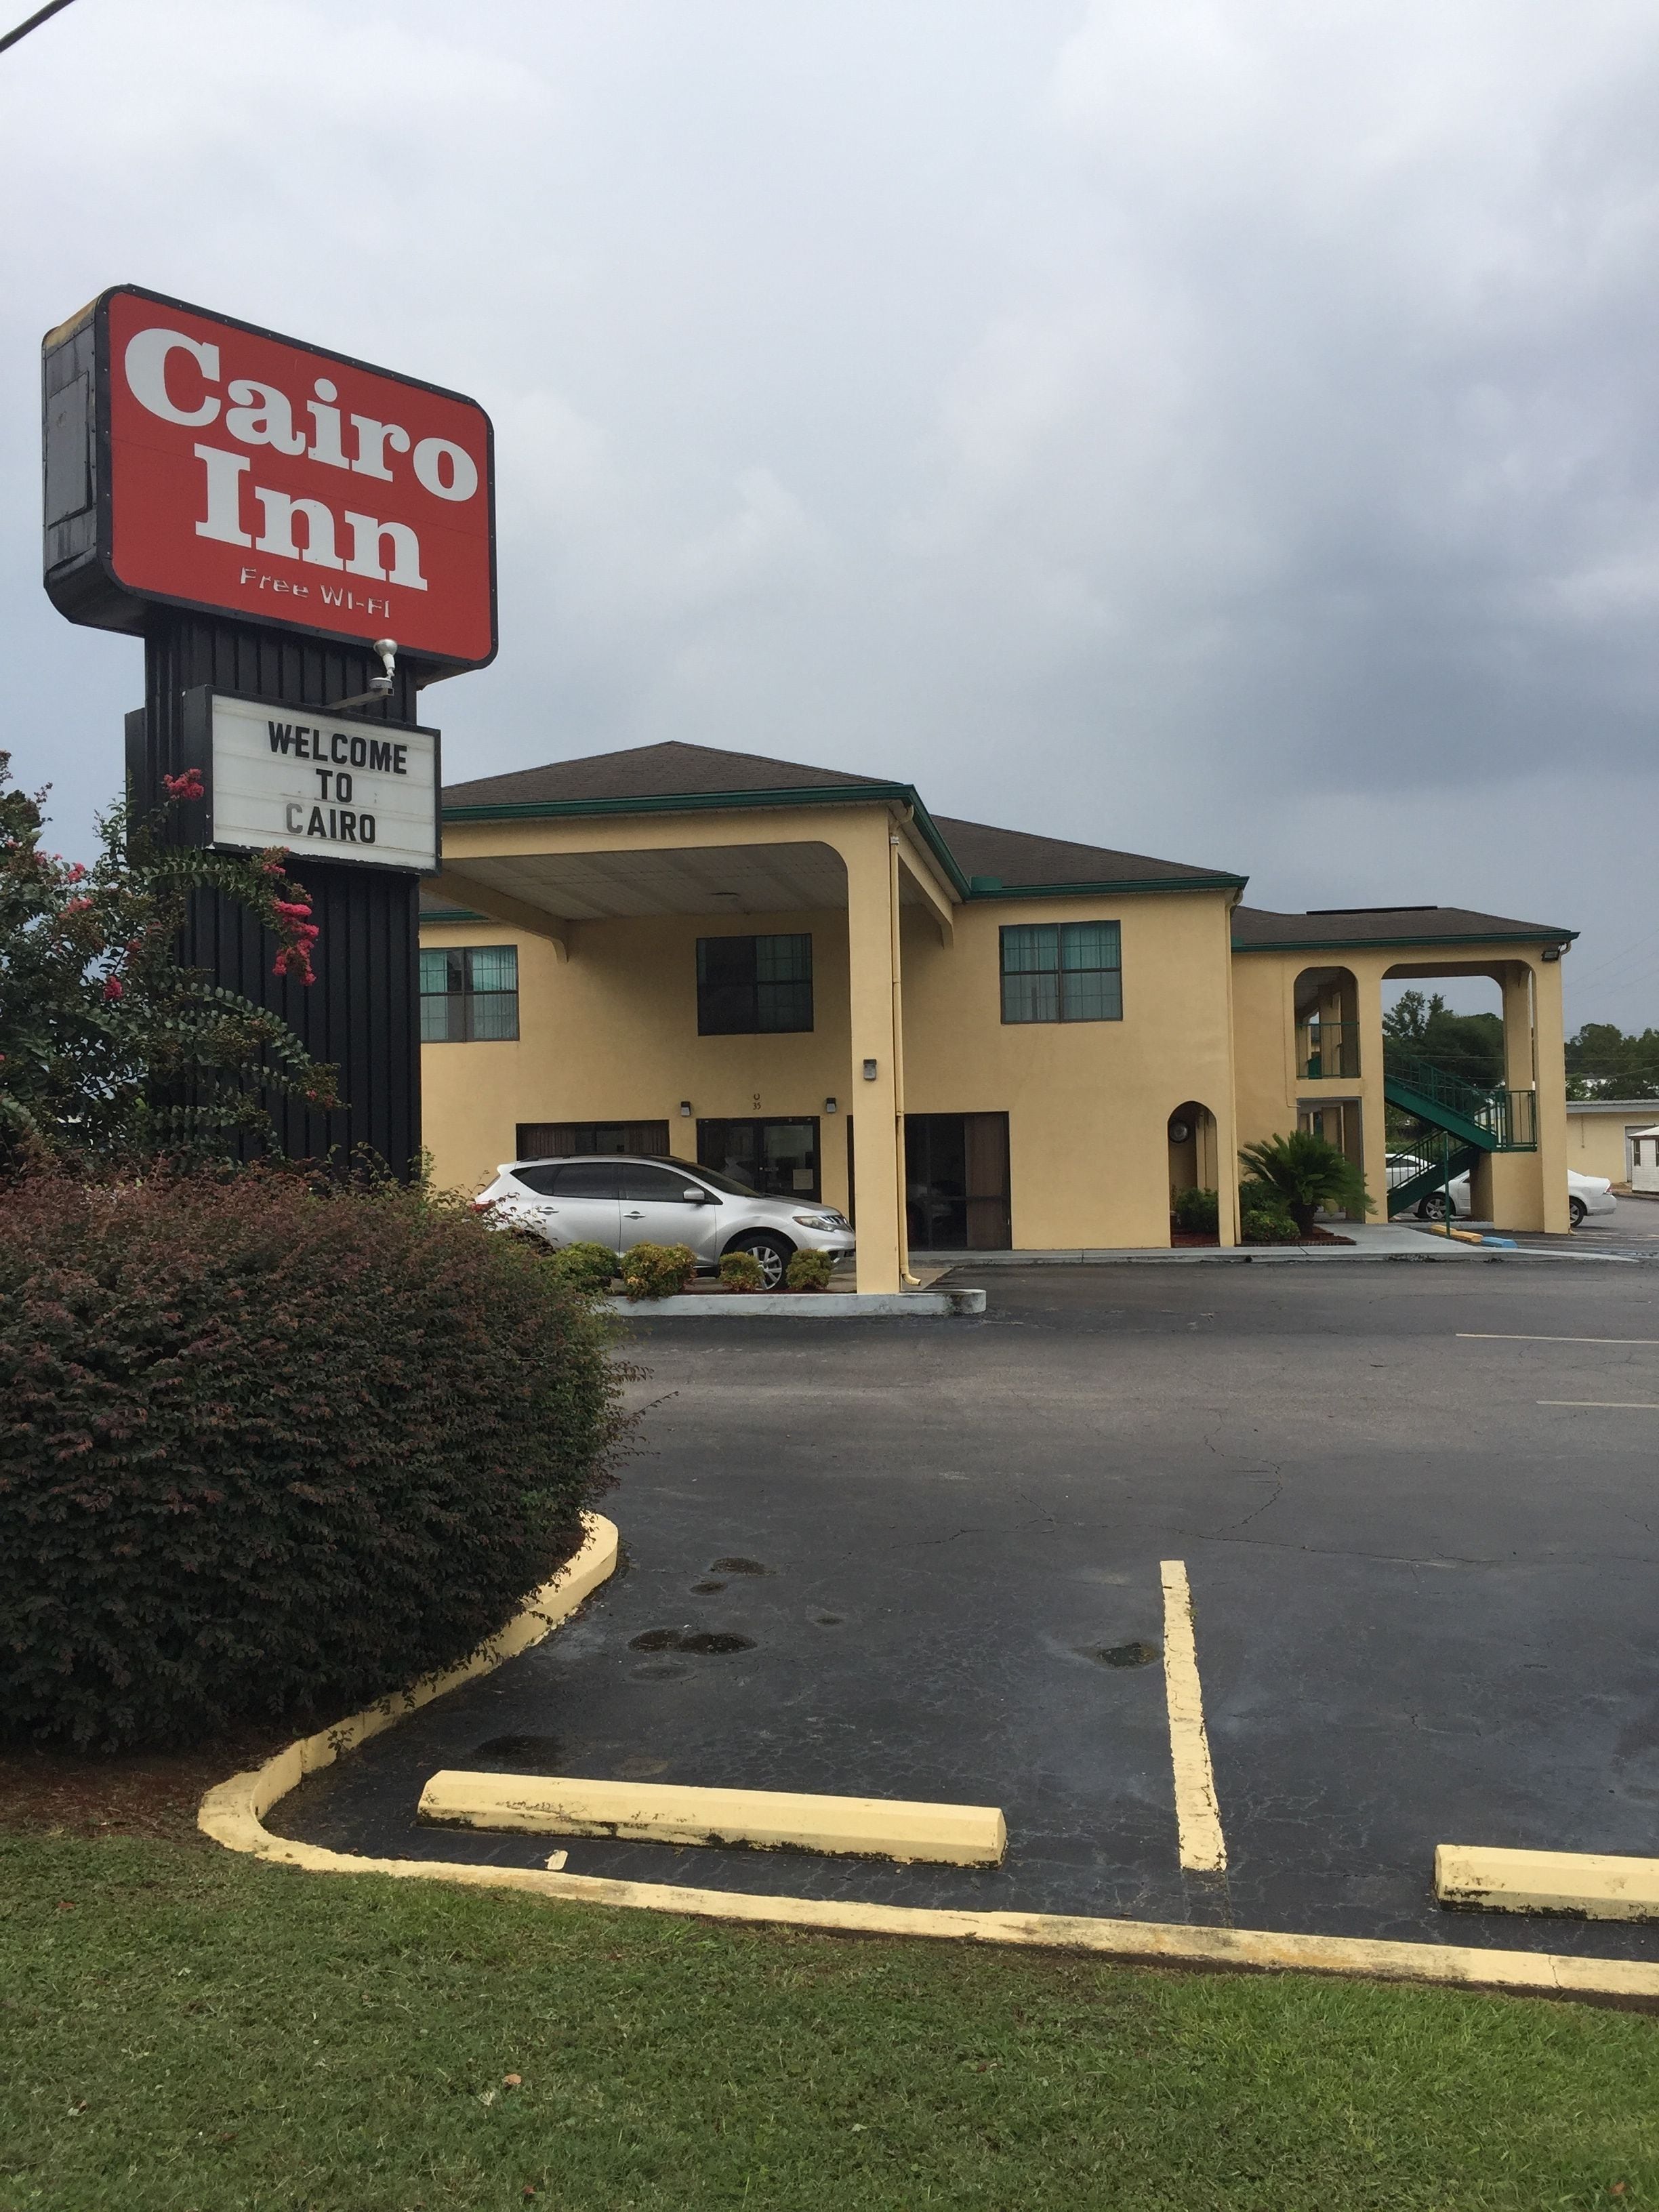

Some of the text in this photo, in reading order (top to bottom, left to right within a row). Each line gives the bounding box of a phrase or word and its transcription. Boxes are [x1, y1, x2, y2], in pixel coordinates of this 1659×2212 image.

[125, 328, 478, 502] Cairo
[194, 443, 428, 591] Inn
[240, 567, 309, 598] Free
[268, 720, 407, 775] WELCOME
[316, 768, 352, 803] TO
[286, 803, 376, 844] CAIRO
